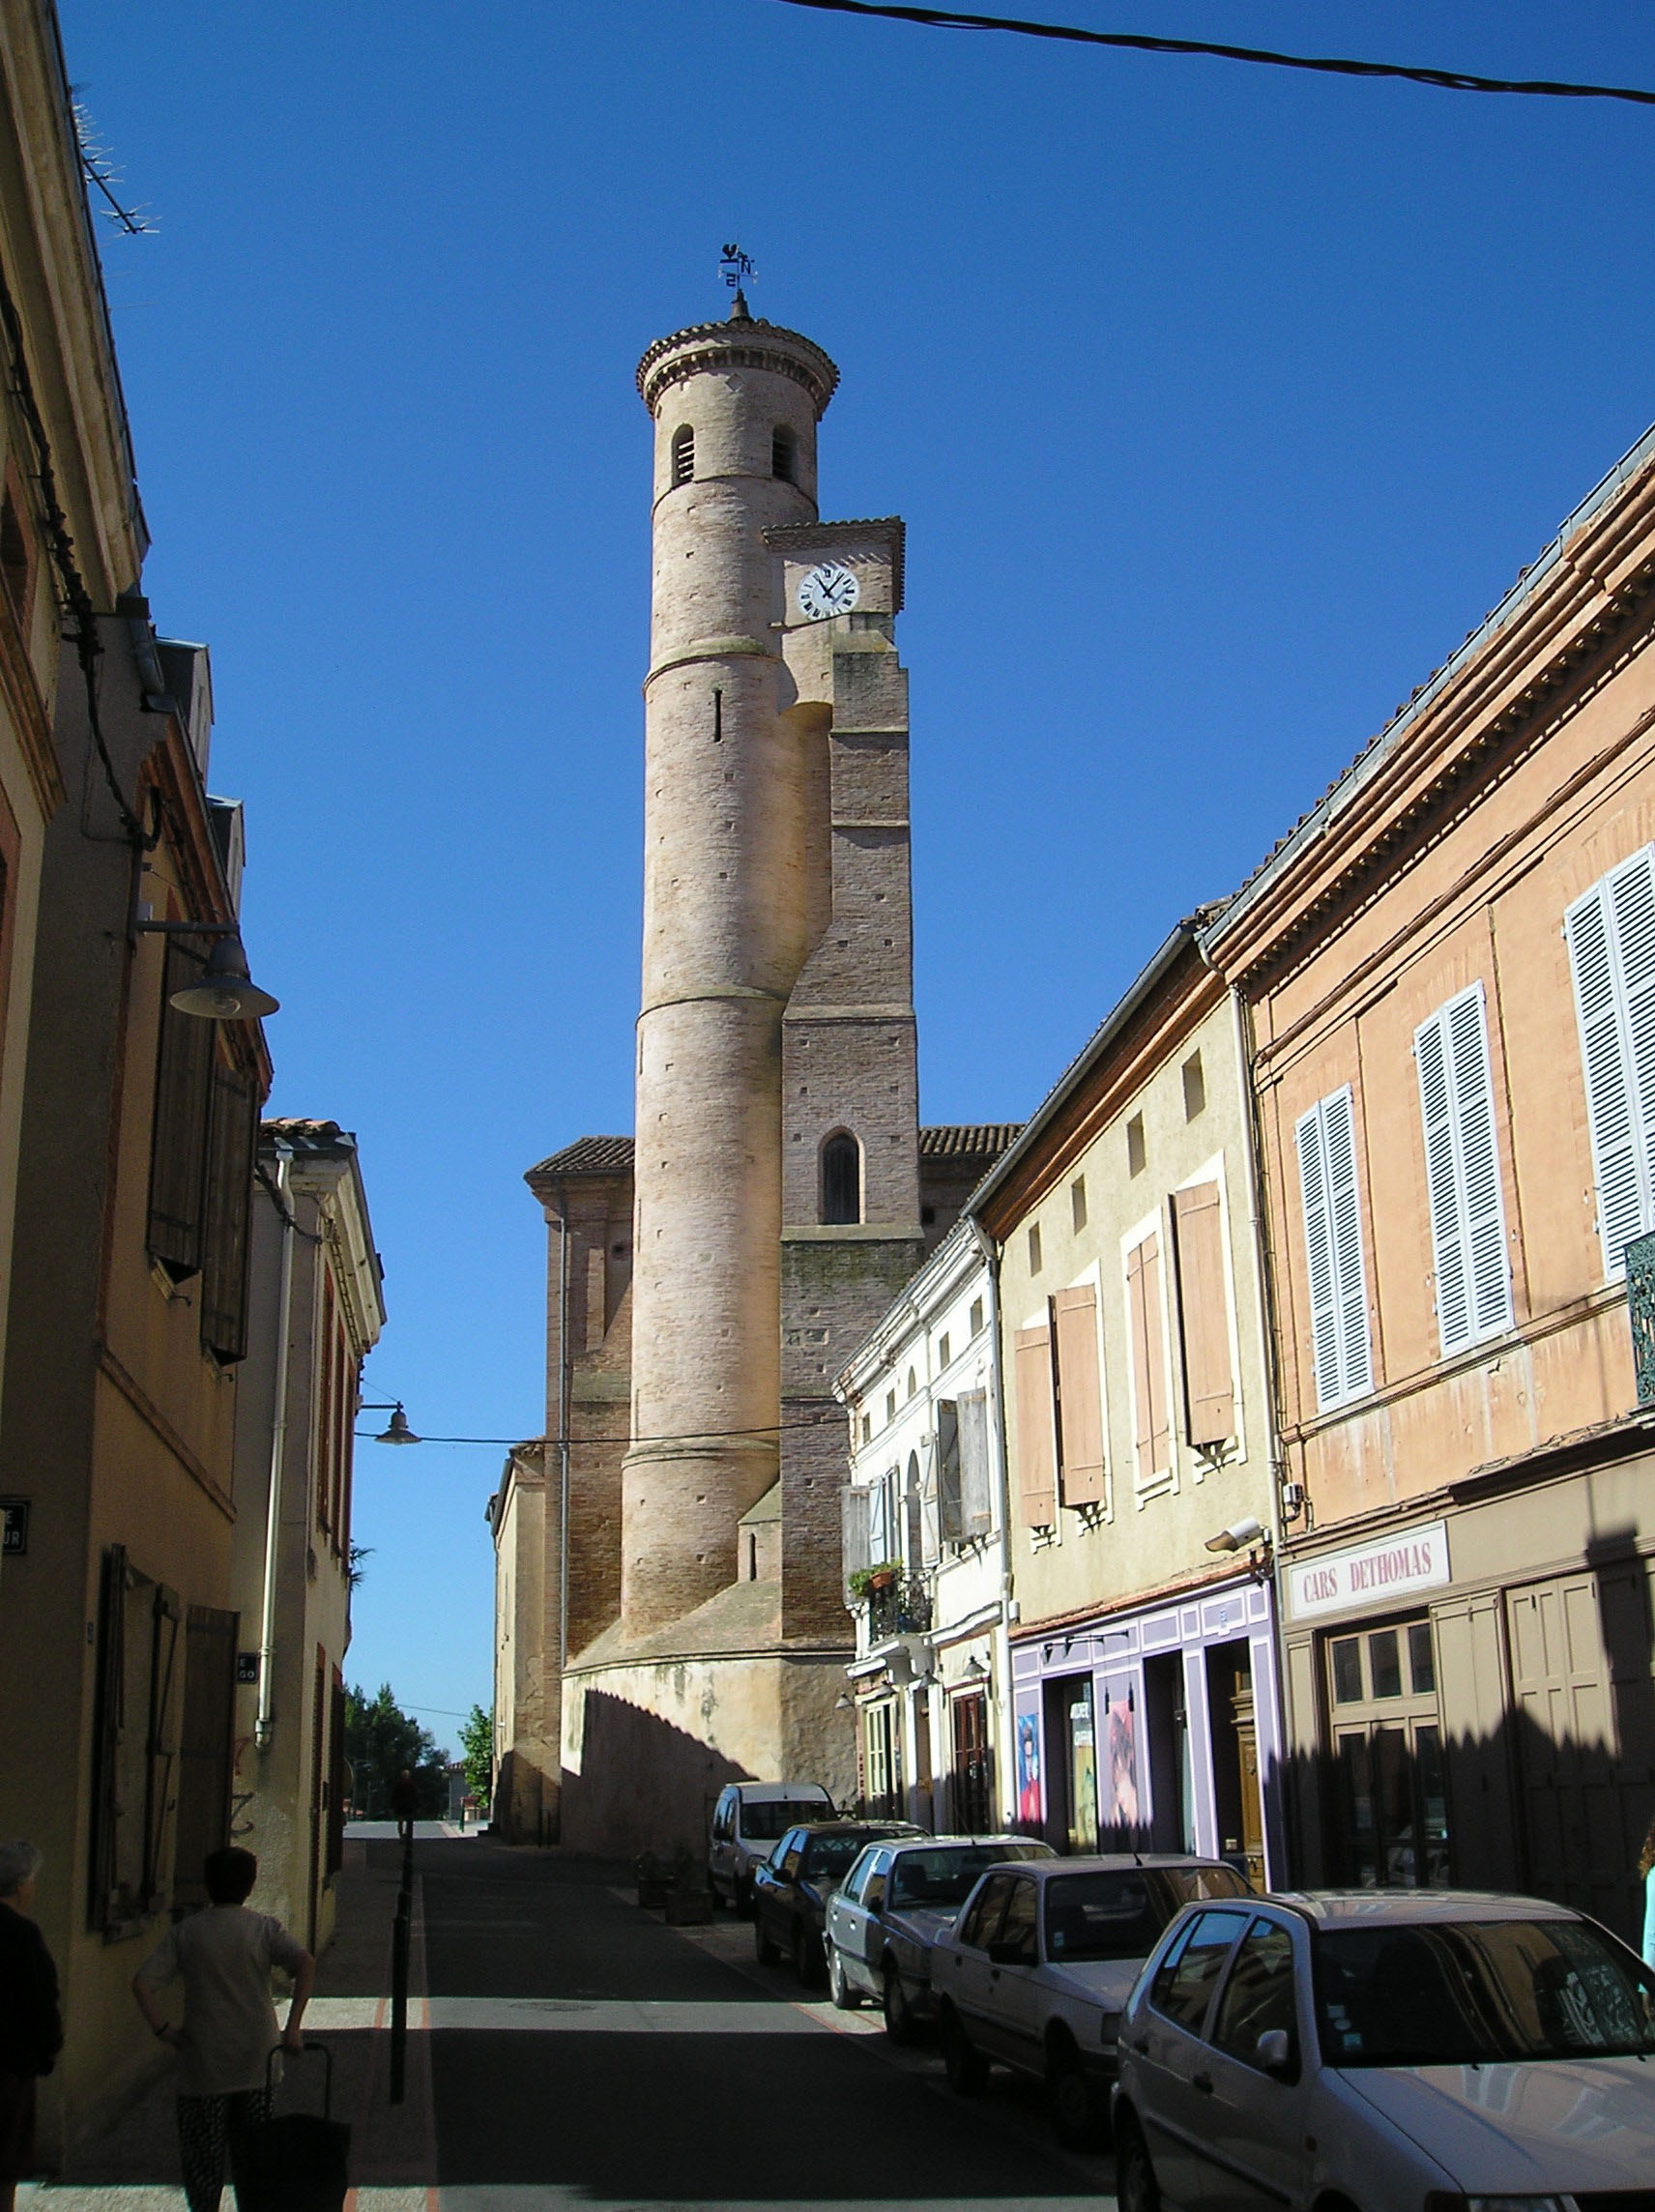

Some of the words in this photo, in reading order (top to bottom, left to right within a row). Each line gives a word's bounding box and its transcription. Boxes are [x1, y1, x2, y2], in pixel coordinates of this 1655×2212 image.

[2, 1530, 20, 1546] UR
[1303, 1567, 1338, 1603] CARS
[1350, 1542, 1432, 1592] DETHOMAS
[240, 1671, 255, 1679] GO
